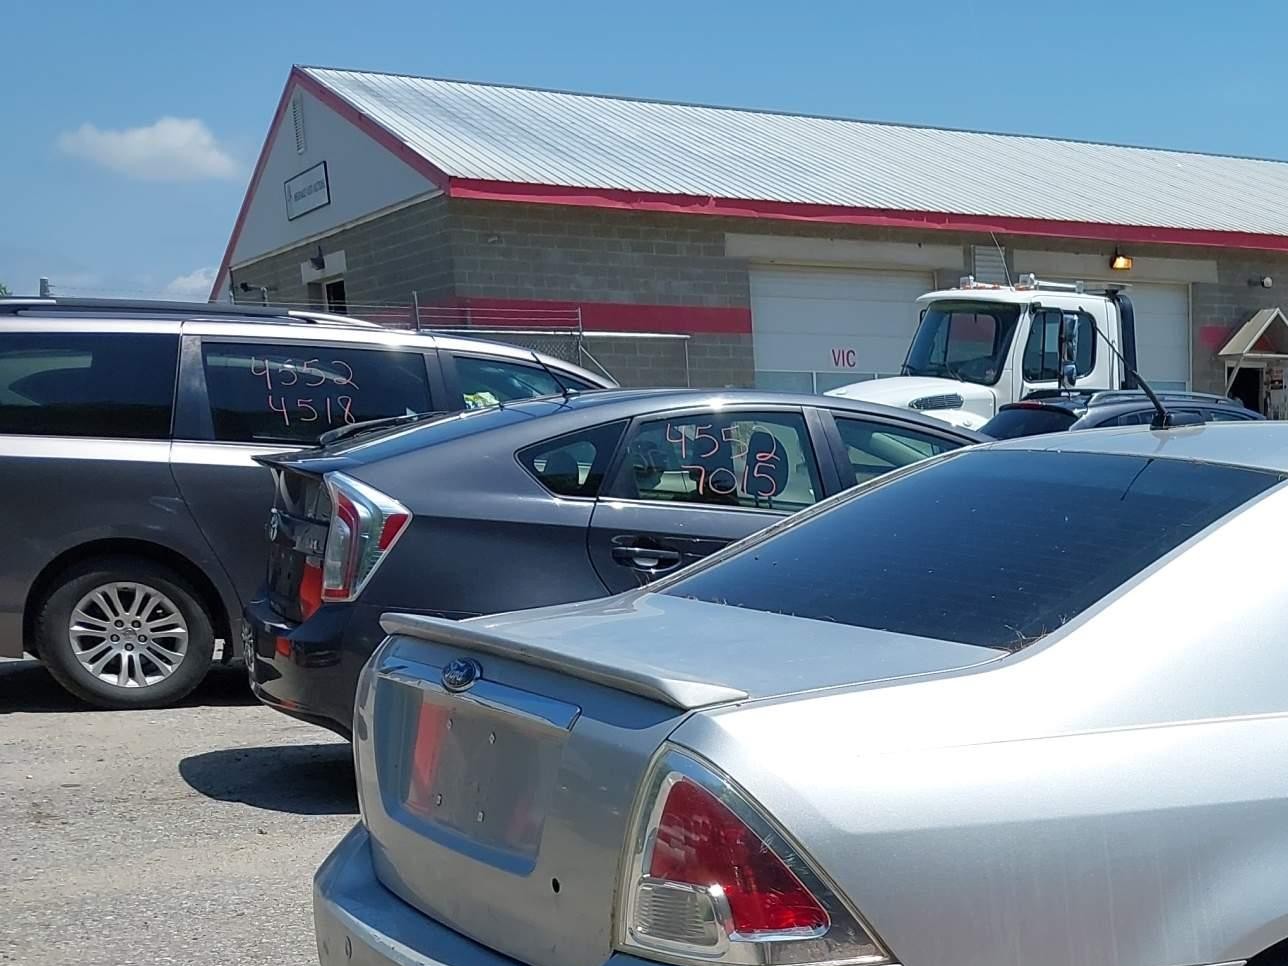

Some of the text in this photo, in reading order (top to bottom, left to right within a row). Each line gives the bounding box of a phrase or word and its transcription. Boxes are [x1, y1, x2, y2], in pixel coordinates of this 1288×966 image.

[251, 356, 360, 390] 4552
[831, 349, 856, 367] VIC
[268, 394, 355, 426] 4518
[666, 423, 781, 461] 4552
[680, 462, 777, 497] 7015
